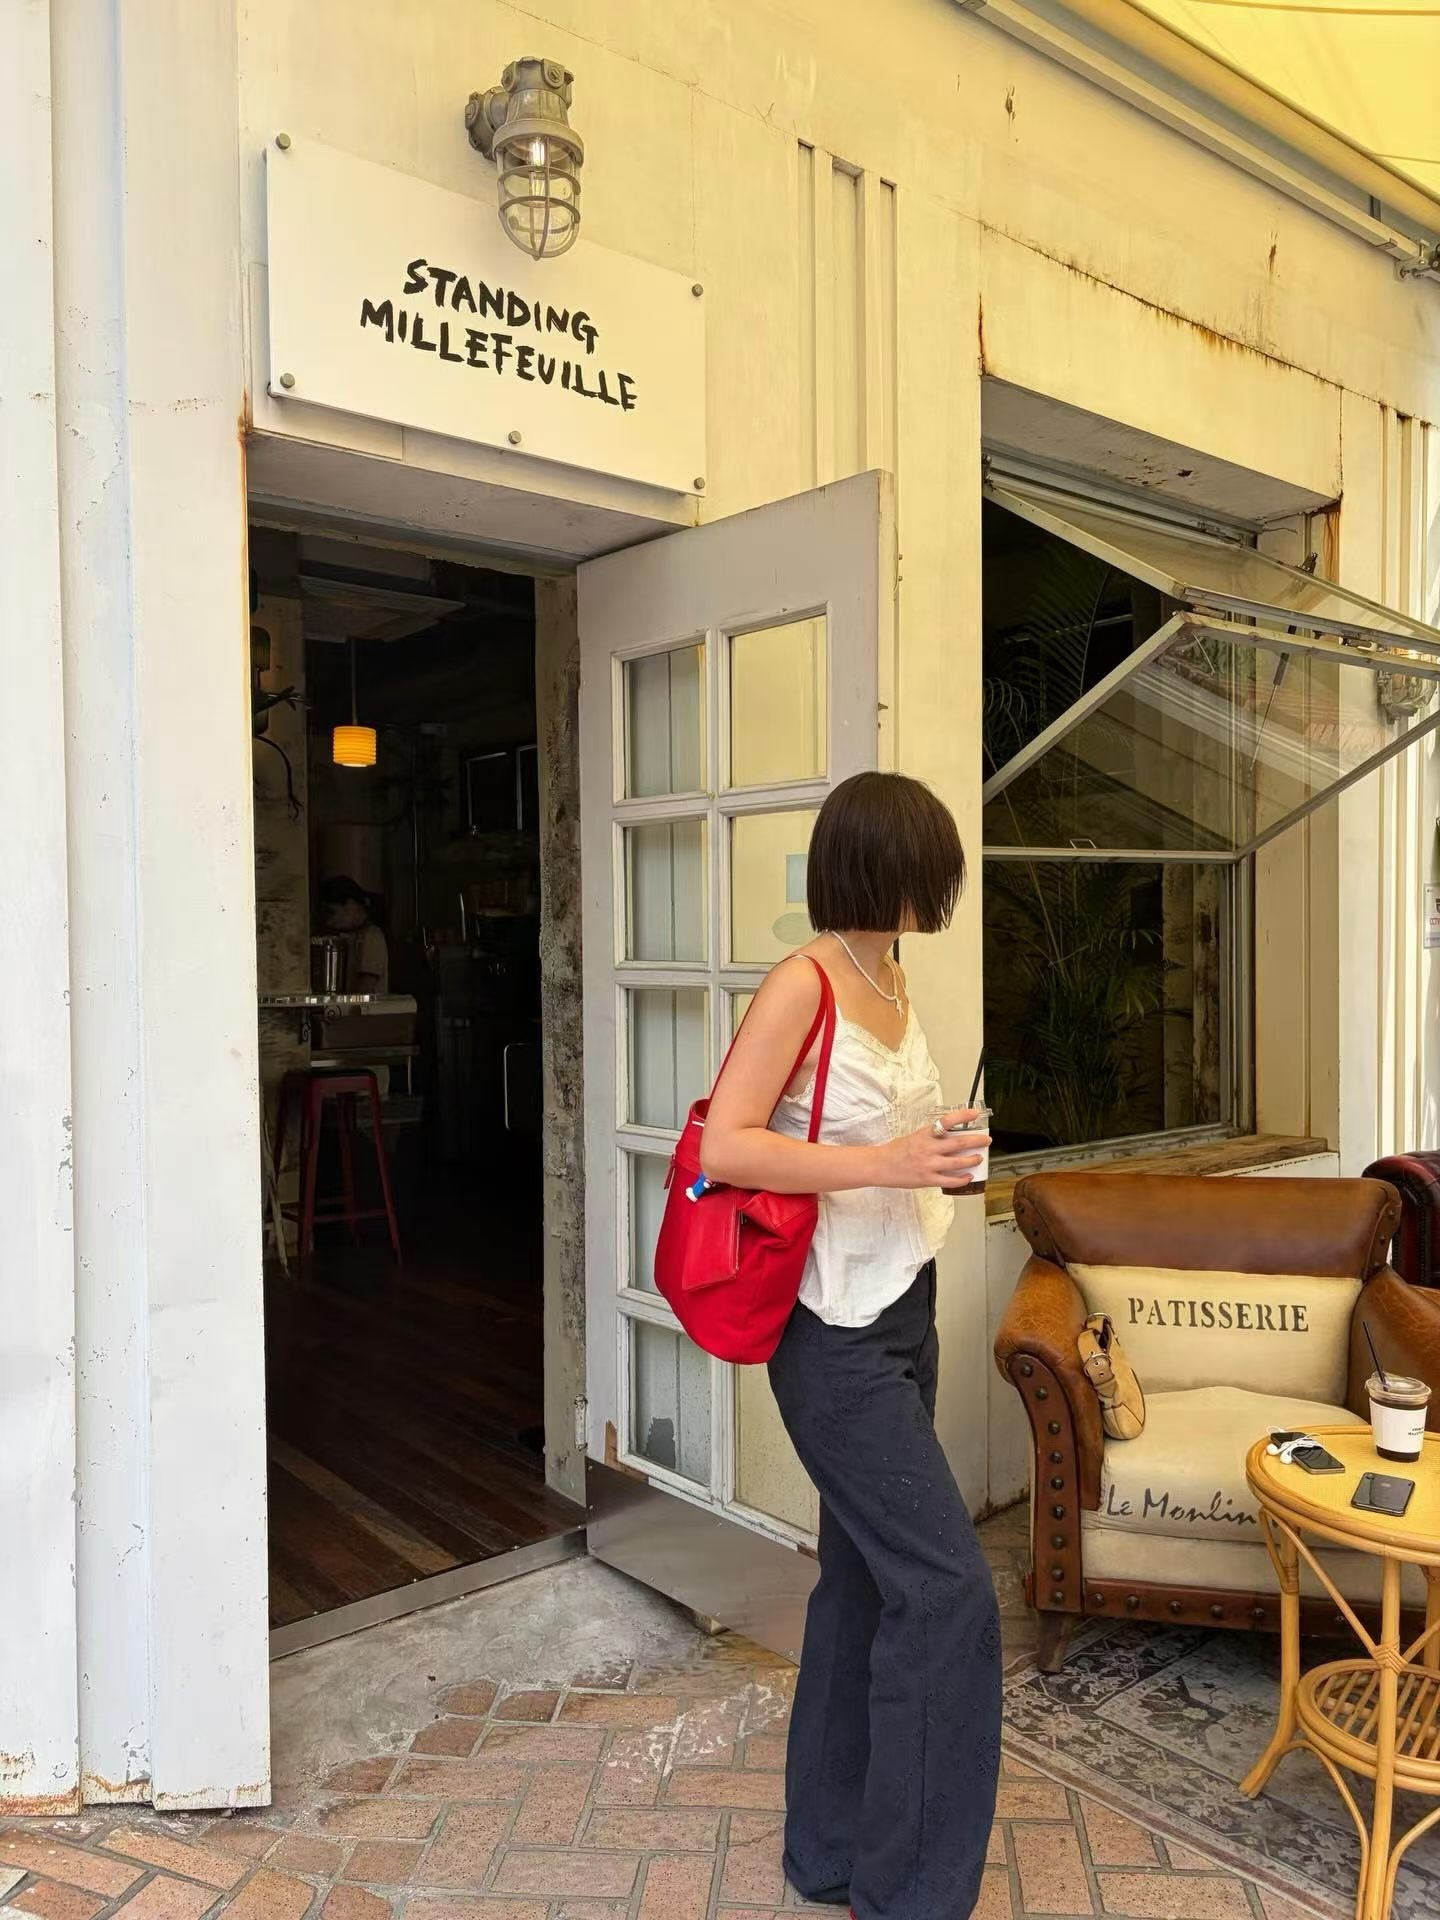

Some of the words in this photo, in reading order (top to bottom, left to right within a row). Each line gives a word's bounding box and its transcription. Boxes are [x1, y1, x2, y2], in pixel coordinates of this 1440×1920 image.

[403, 258, 600, 354] STANDING
[360, 298, 638, 412] MILLEFEUILLE
[1128, 1297, 1309, 1332] PATISSERIE
[1107, 1484, 1133, 1516] Le
